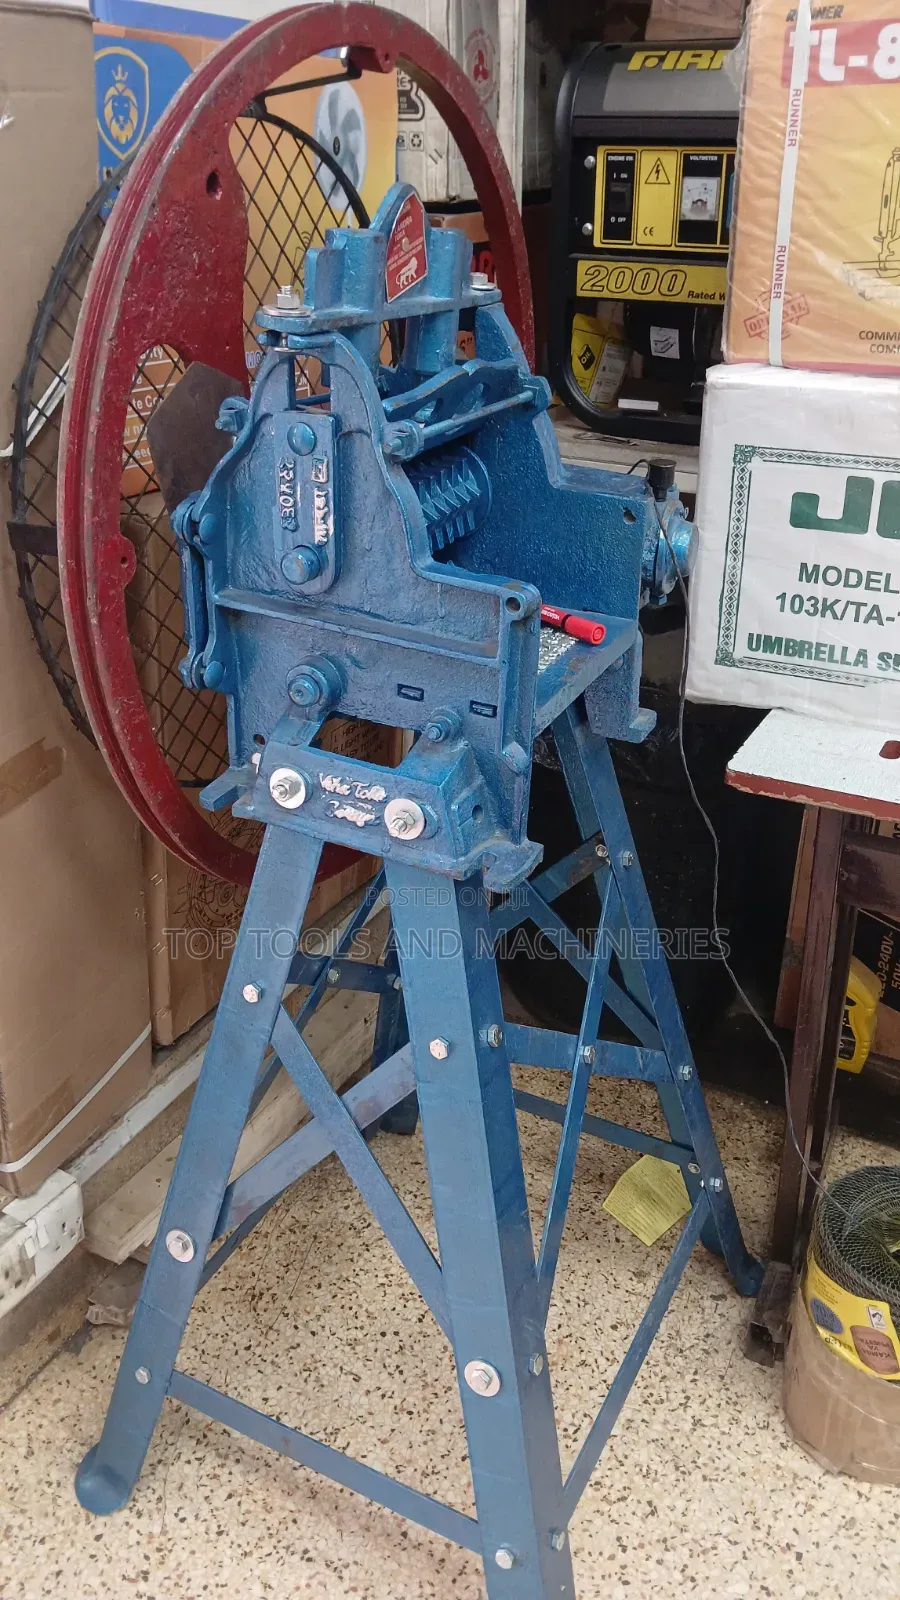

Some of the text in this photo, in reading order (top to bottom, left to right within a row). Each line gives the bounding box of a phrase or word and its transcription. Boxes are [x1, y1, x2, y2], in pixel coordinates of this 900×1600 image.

[787, 88, 802, 147] RUNNER
[580, 264, 687, 297] 2000
[772, 245, 787, 299] RUNNER
[687, 290, 716, 300] Rated
[798, 562, 900, 595] MODEL
[746, 632, 869, 669] UMBRELLA
